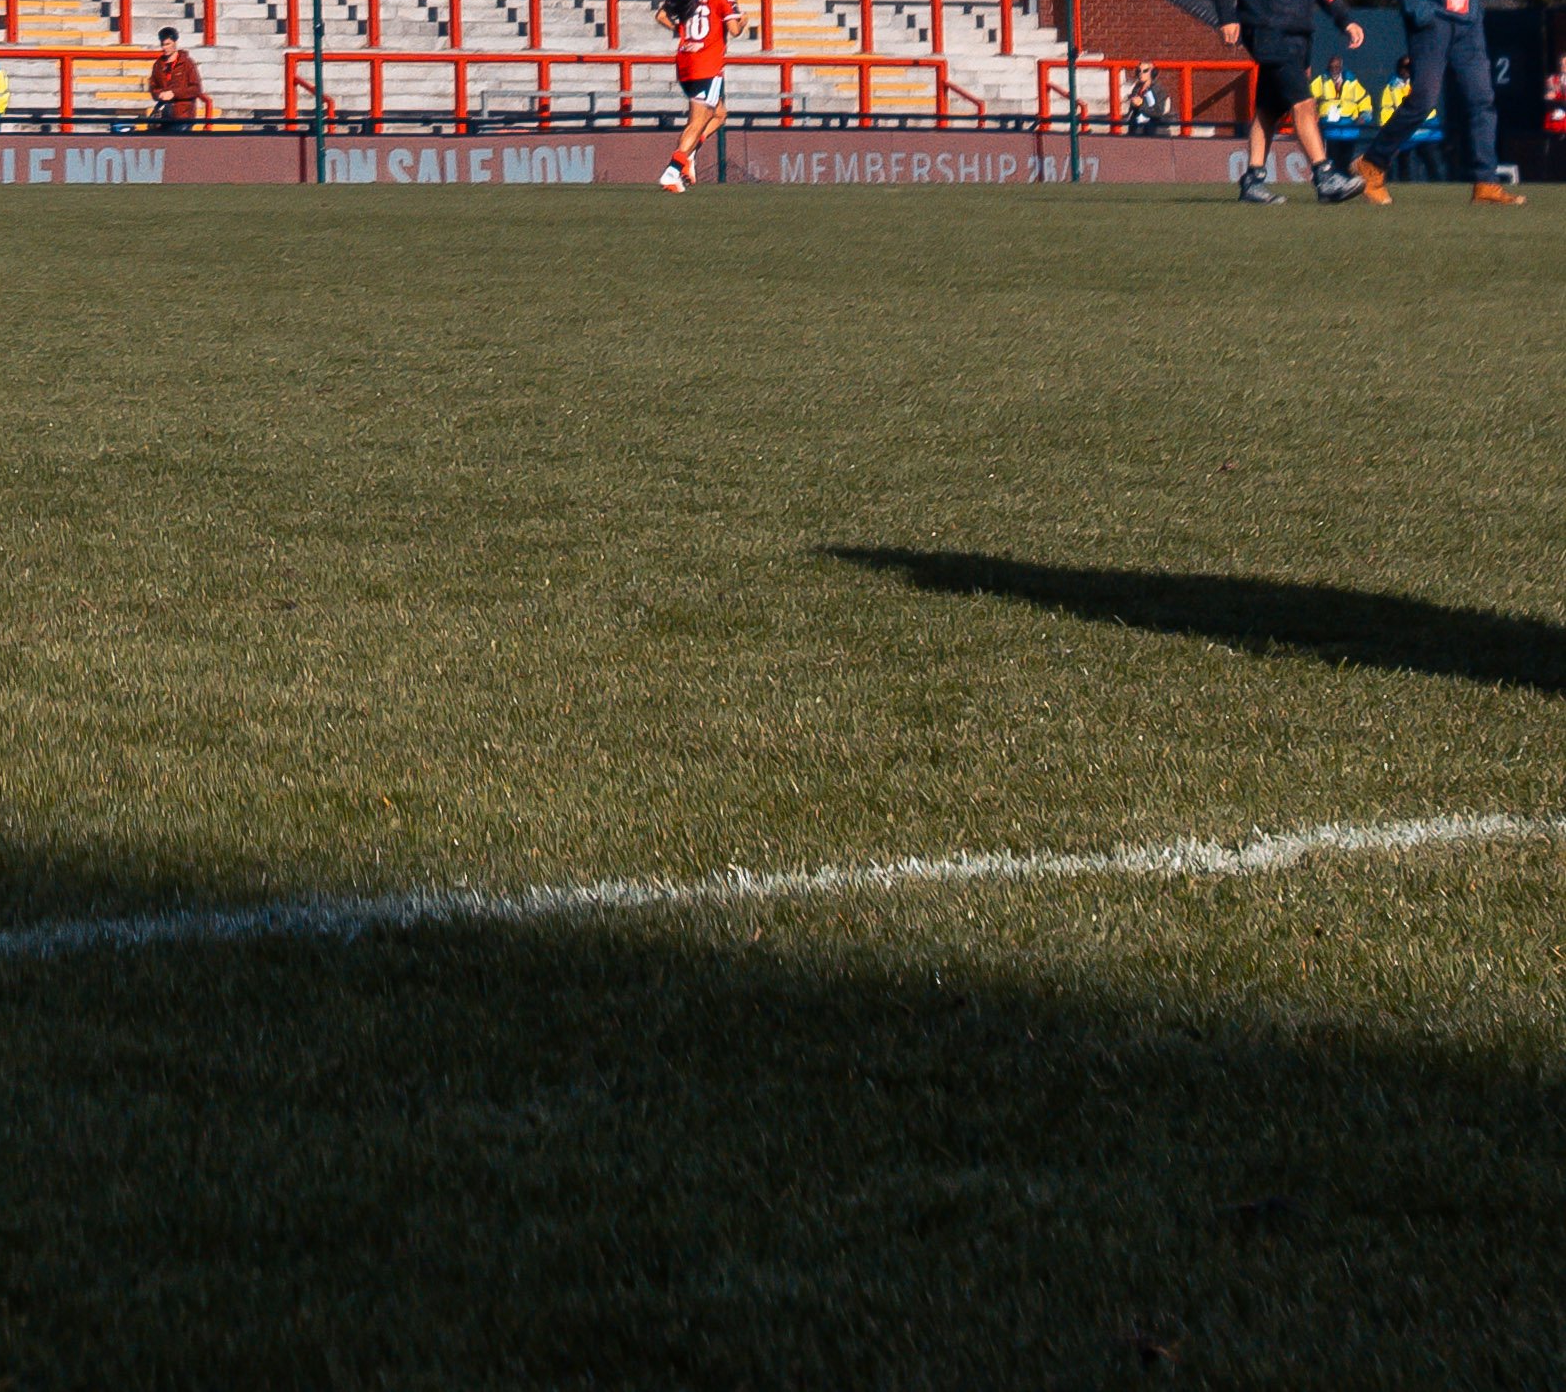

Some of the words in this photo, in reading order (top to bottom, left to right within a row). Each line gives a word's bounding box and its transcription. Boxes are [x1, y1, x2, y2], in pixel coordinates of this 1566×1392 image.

[1495, 57, 1510, 85] 2
[64, 147, 166, 184] NOW
[325, 148, 377, 183] ON
[387, 147, 493, 183] SALE
[502, 144, 595, 183] NOW
